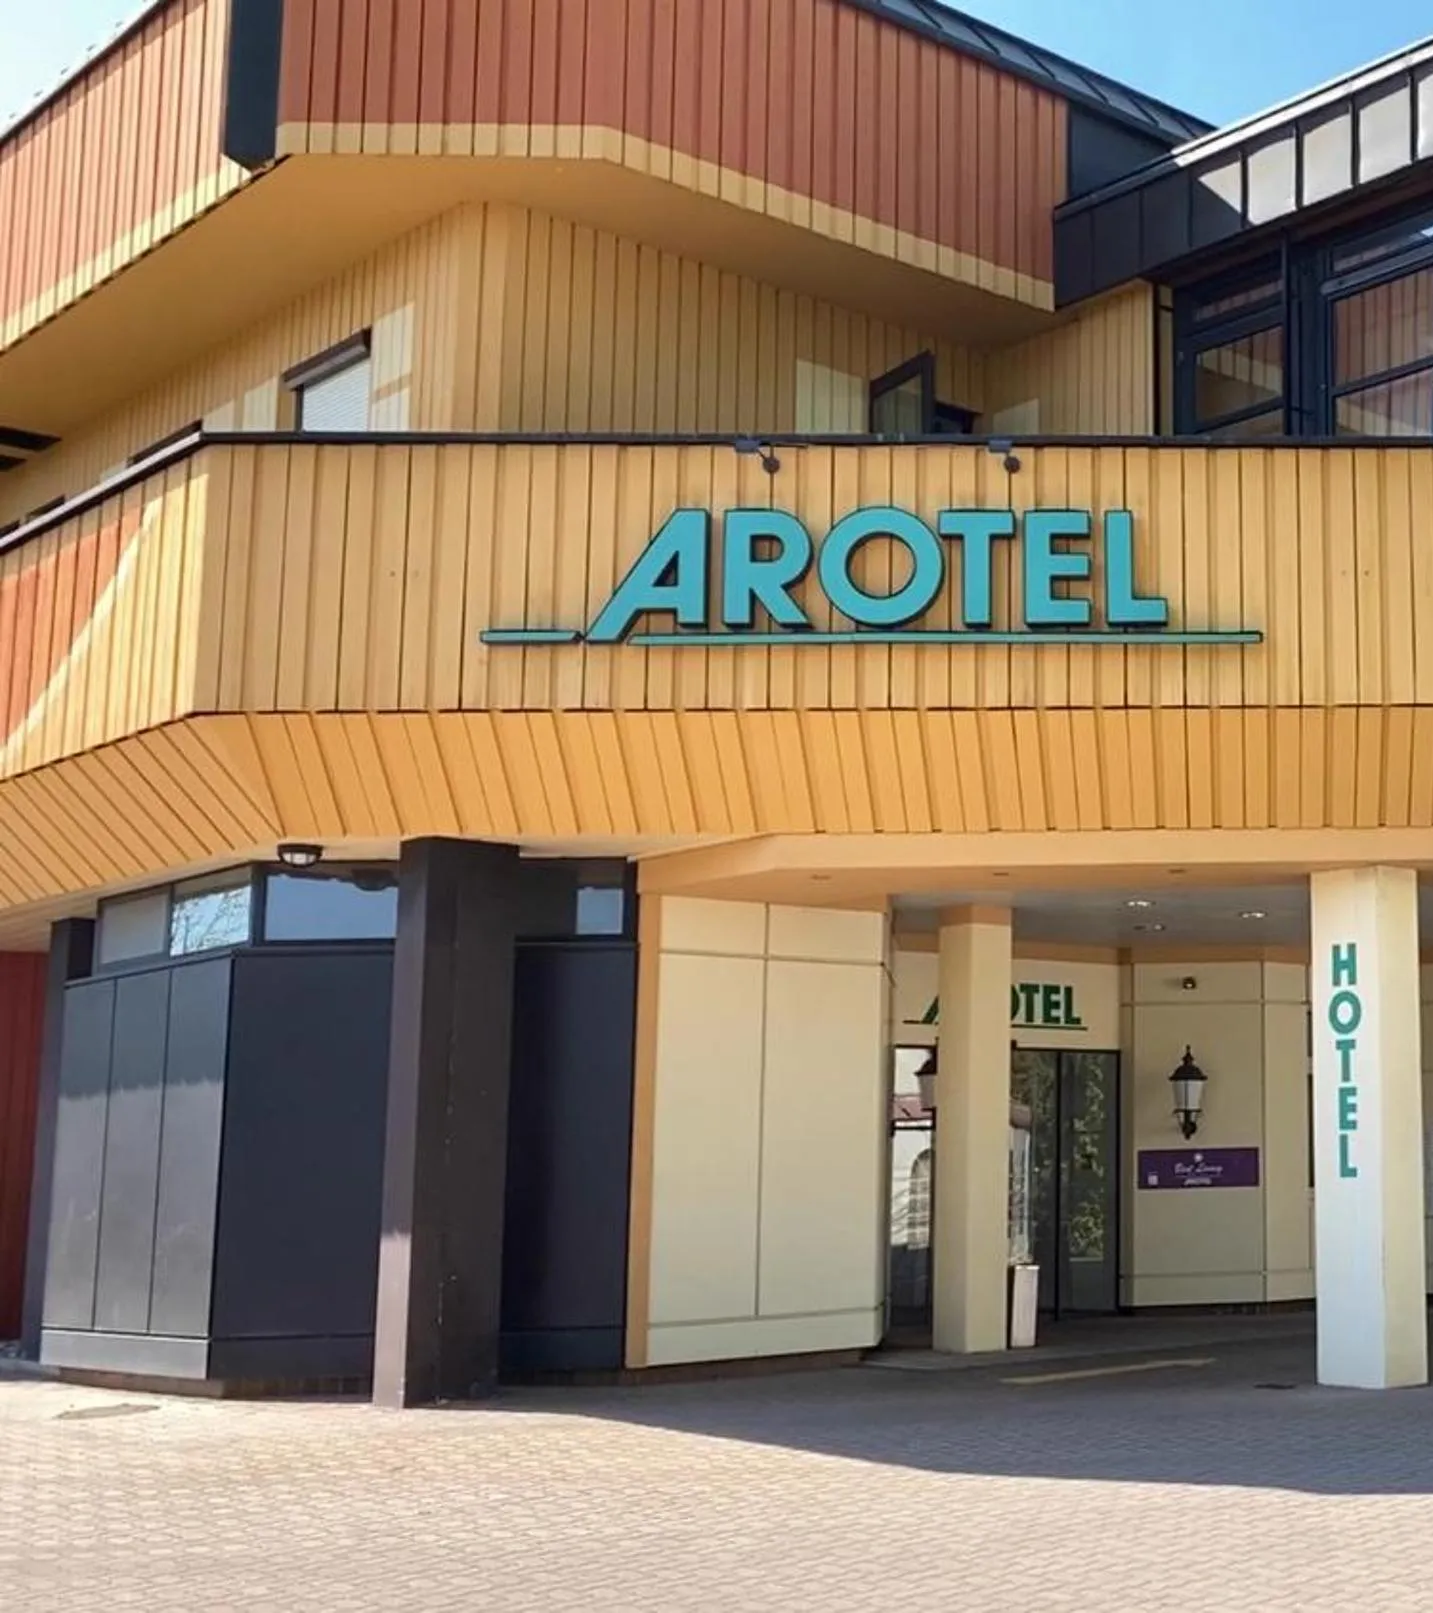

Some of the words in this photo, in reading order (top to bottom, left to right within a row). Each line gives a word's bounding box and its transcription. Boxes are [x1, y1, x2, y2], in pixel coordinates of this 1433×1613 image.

[585, 506, 1168, 643] AROTEL
[921, 982, 1082, 1024] TEL
[1328, 942, 1361, 1178] HOTEL
